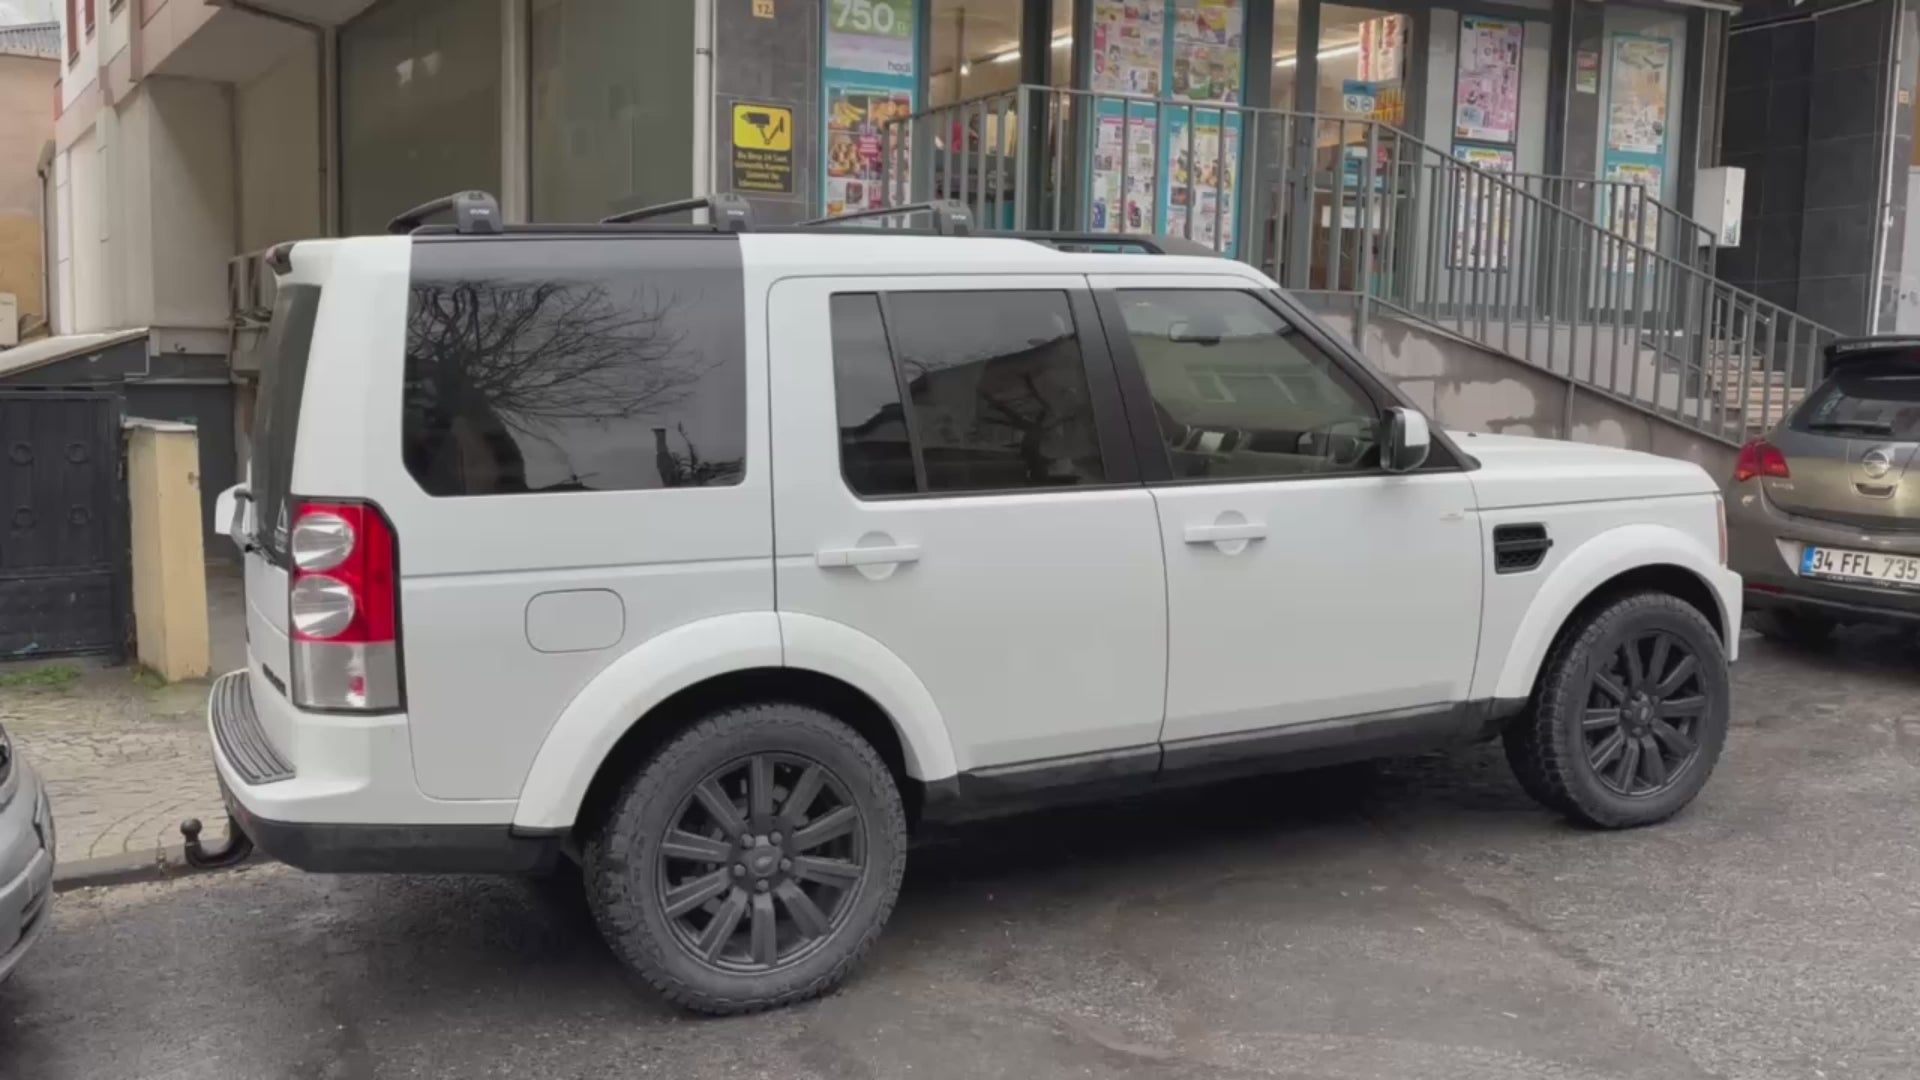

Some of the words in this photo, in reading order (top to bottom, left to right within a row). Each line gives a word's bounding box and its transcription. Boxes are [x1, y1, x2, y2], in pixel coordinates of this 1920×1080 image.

[836, 0, 894, 33] 750
[1813, 549, 1833, 571] 34
[1840, 552, 1873, 576] FFL
[1882, 557, 1919, 580] 735
